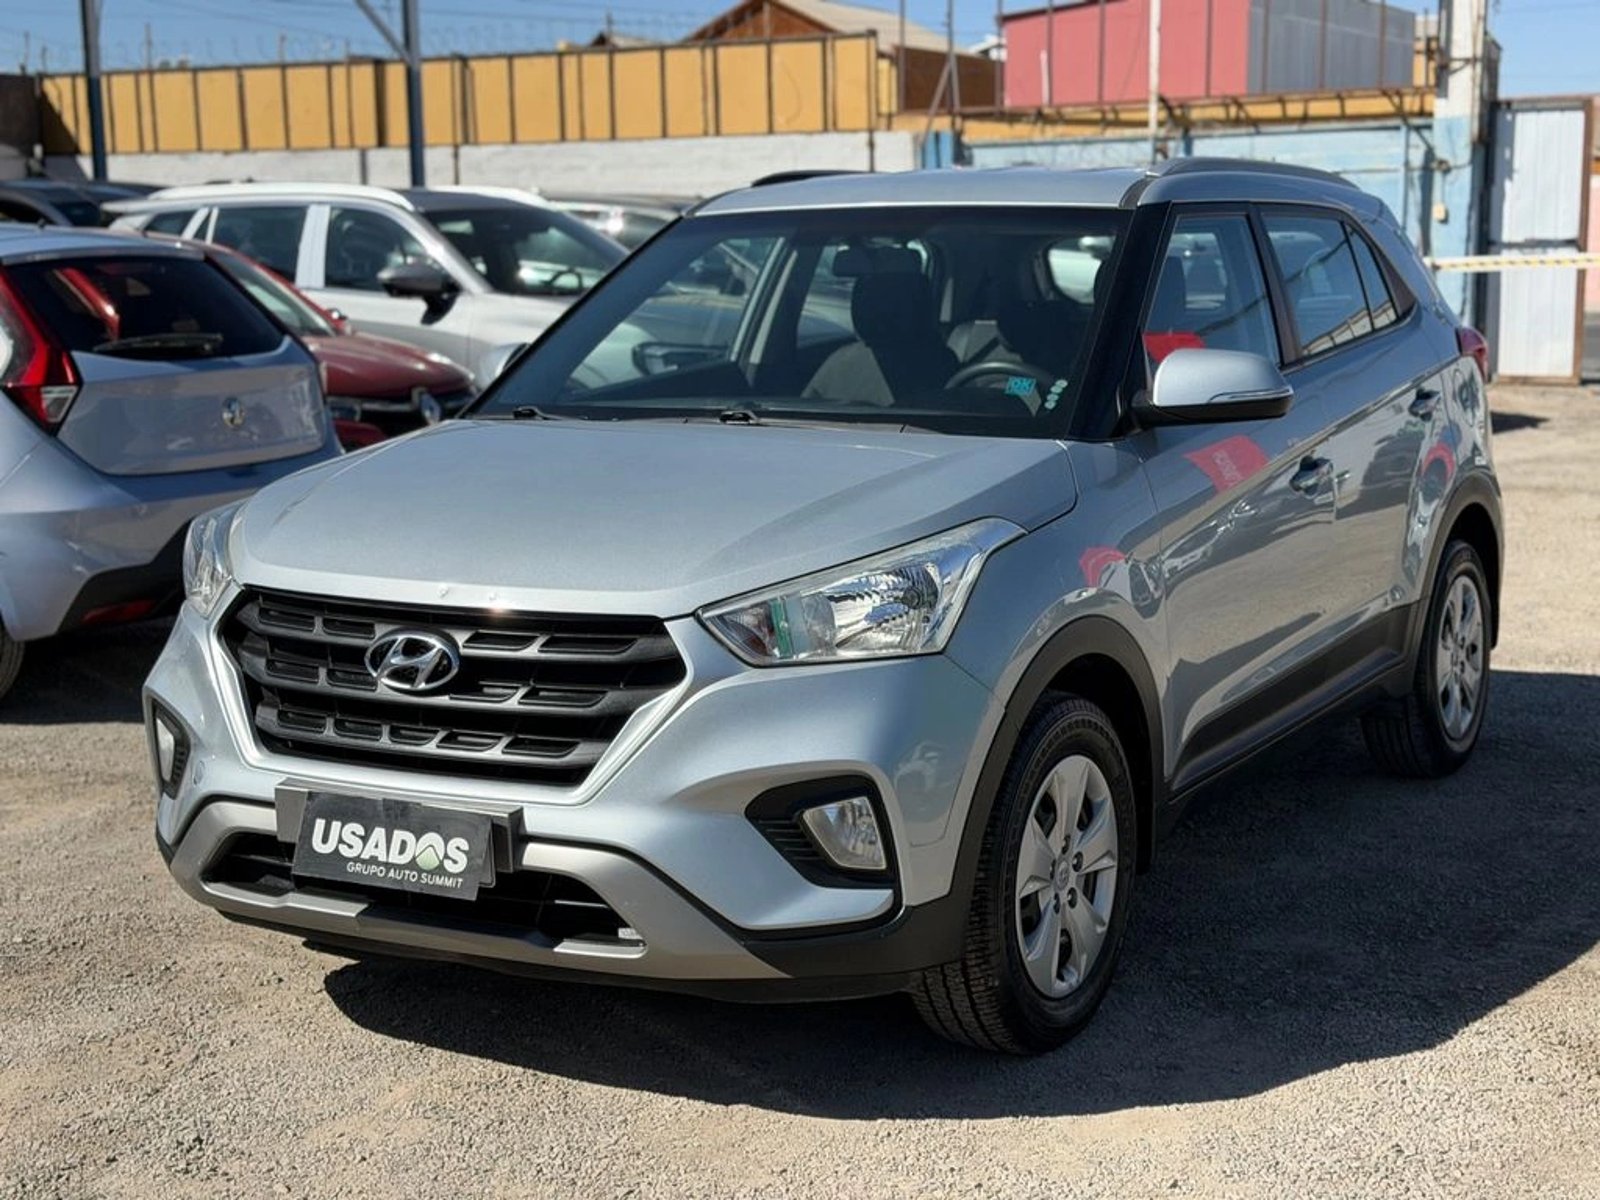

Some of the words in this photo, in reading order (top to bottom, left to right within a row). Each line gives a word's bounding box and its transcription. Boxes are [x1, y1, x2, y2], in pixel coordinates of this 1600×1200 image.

[311, 818, 470, 873] USADOS
[346, 861, 386, 878] GRUPO
[387, 868, 418, 882] AUTO
[420, 872, 464, 889] SUMMIT
